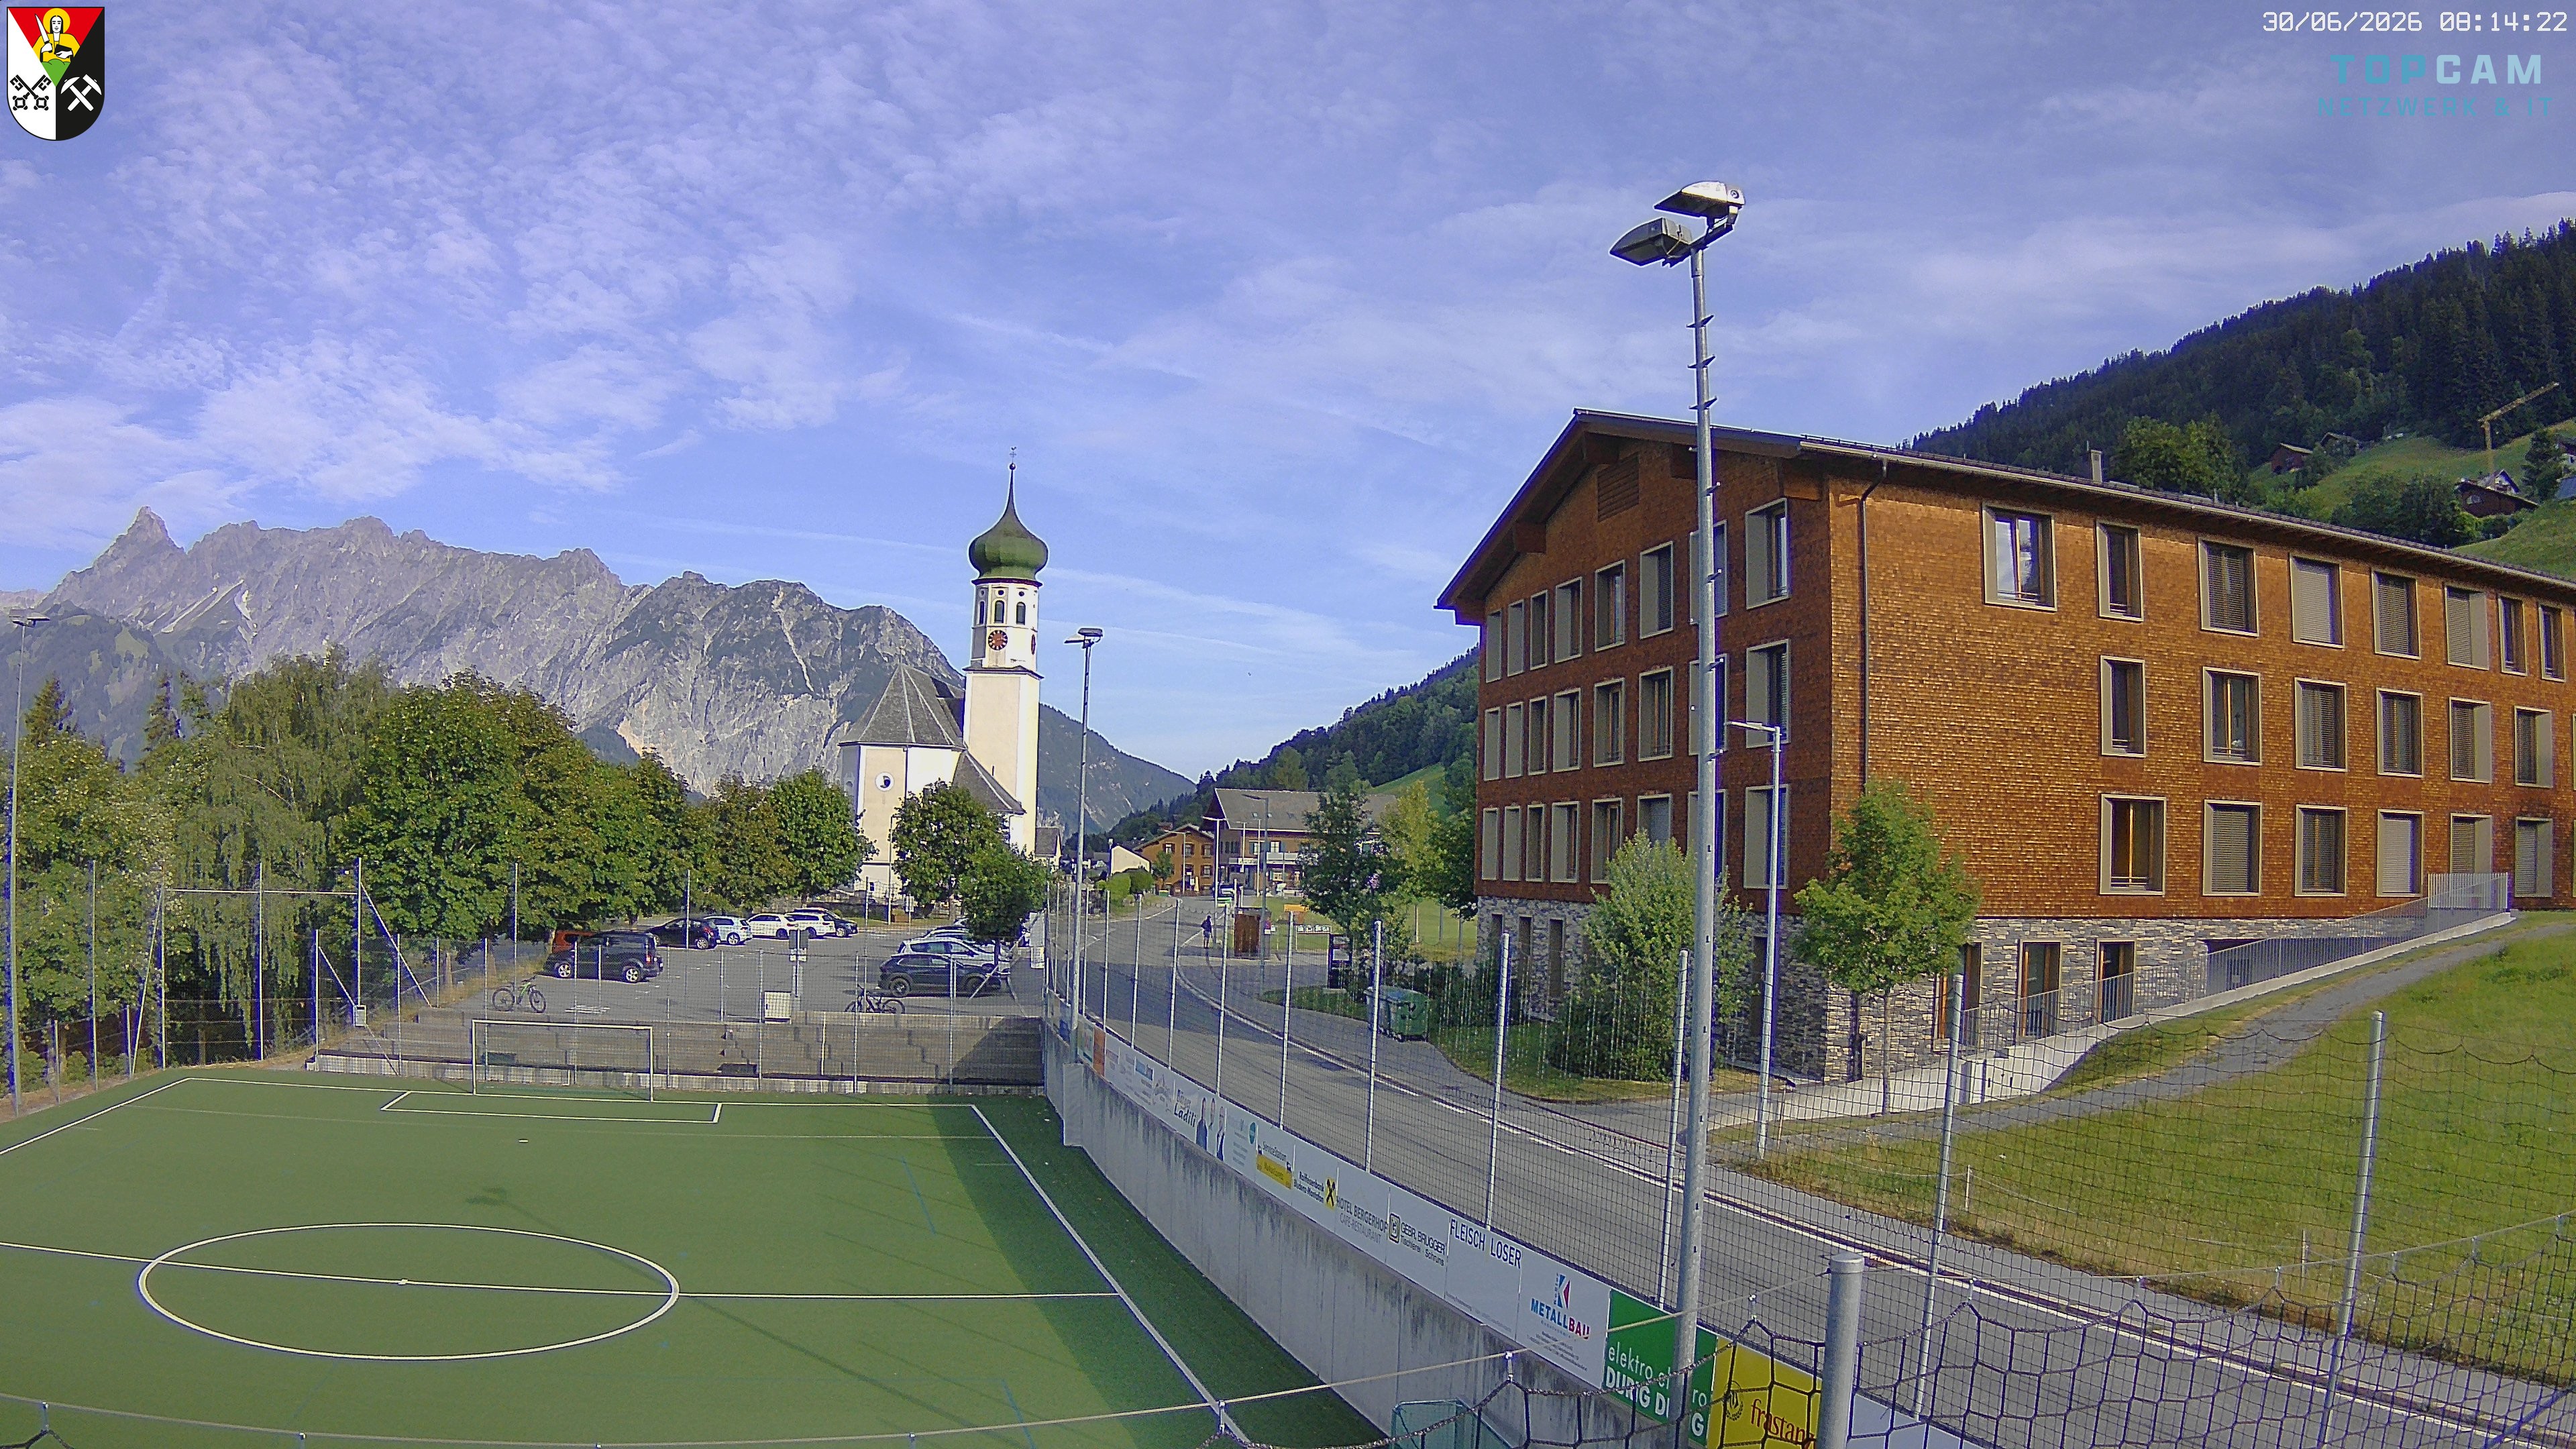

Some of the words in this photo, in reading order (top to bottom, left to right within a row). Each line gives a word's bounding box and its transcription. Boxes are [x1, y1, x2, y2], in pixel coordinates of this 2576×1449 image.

[1354, 1205, 1388, 1233] BERGERHOF
[1417, 1231, 1446, 1255] BRUGGER
[1450, 1218, 1486, 1251] FLEISCH
[1490, 1237, 1521, 1269] LOSER
[1530, 1297, 1590, 1340] METALLBAU
[1608, 1341, 1653, 1380] elektro
